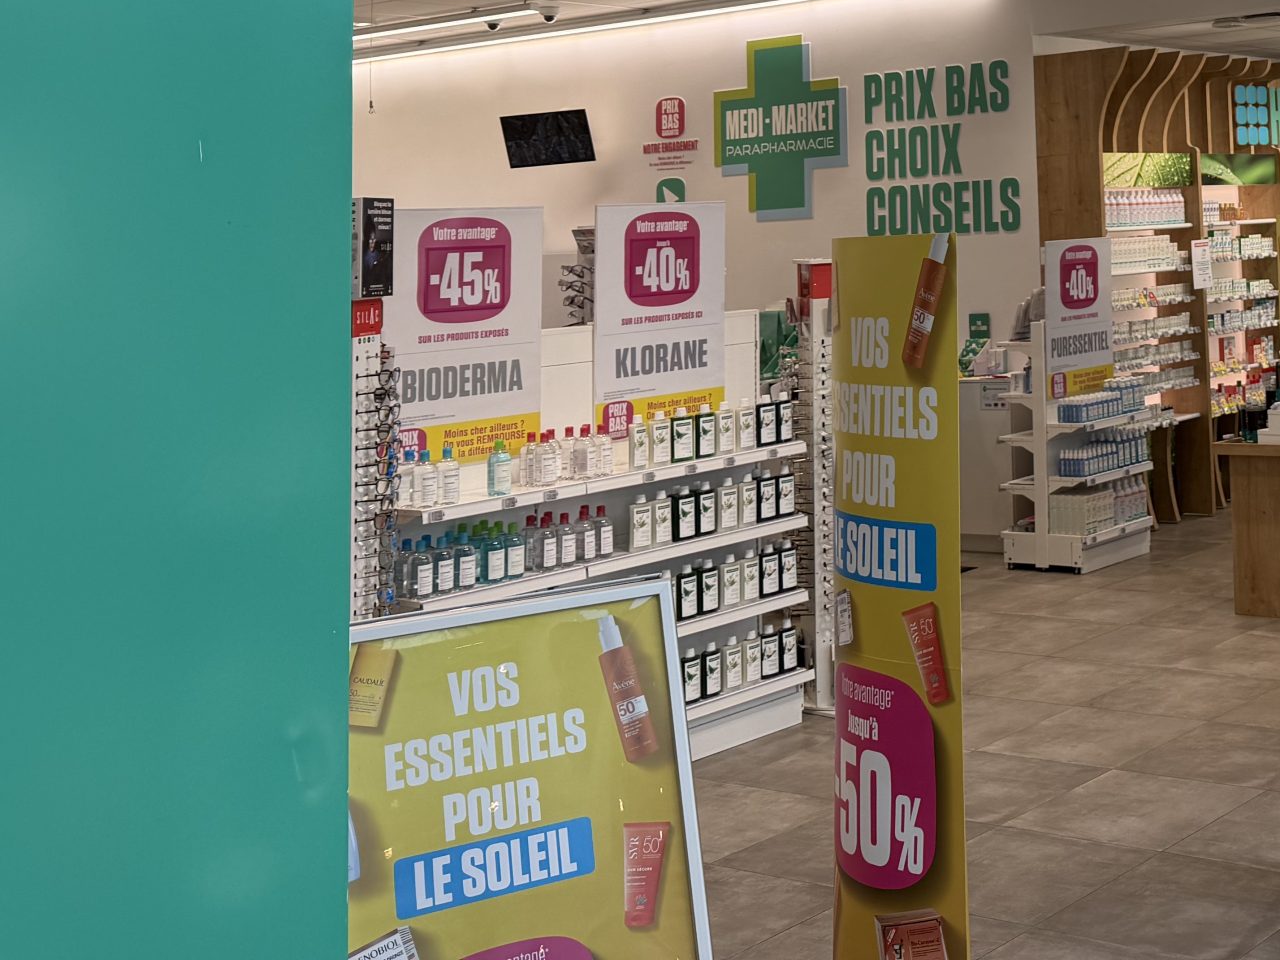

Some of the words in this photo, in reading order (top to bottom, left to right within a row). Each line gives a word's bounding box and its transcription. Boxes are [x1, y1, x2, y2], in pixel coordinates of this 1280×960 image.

[662, 99, 679, 113] PRIX
[864, 67, 937, 124] PRIX
[945, 59, 1010, 117] BAS
[662, 114, 679, 129] BAS
[726, 137, 835, 156] PARAPHARMACIE
[865, 123, 962, 181] CHOIX
[637, 220, 656, 233] Votre
[866, 177, 1021, 236] CONSEILS
[433, 226, 457, 241] Votre
[430, 251, 501, 307] -45%
[635, 246, 690, 293] -40%
[1065, 268, 1095, 300] -40%
[418, 335, 432, 344] SUR
[433, 334, 445, 342] LES
[446, 331, 479, 342] PRODUITS
[480, 328, 509, 338] EXPOSÉS
[621, 318, 633, 326] SUR
[634, 316, 643, 324] LES
[644, 313, 670, 324] PRODUITS
[615, 338, 708, 379] KLORANE
[851, 317, 889, 369] VOS
[1051, 330, 1109, 359] PURESSENTIEL
[401, 358, 523, 404] BIODERMA
[444, 429, 468, 439] Moins
[470, 427, 488, 436] cher
[489, 422, 518, 433] ailleurs
[520, 420, 525, 428] ?
[608, 402, 628, 417] PRIX
[608, 416, 627, 433] BAS
[832, 384, 938, 441] SSENTIELS
[456, 439, 474, 448] vous
[476, 429, 526, 444] REMBOURSE
[458, 448, 466, 458] la
[467, 442, 506, 456] différe
[842, 450, 896, 508] POUR
[834, 515, 847, 570] LE
[847, 522, 922, 584] SOLEIL
[447, 661, 520, 717] VOS
[848, 709, 878, 741] Jusqu'à
[384, 708, 587, 792] ESSENTIELS
[442, 777, 542, 843] POUR
[834, 738, 924, 875] -50%
[413, 854, 453, 911] LE
[460, 827, 578, 898] SOLEIL
